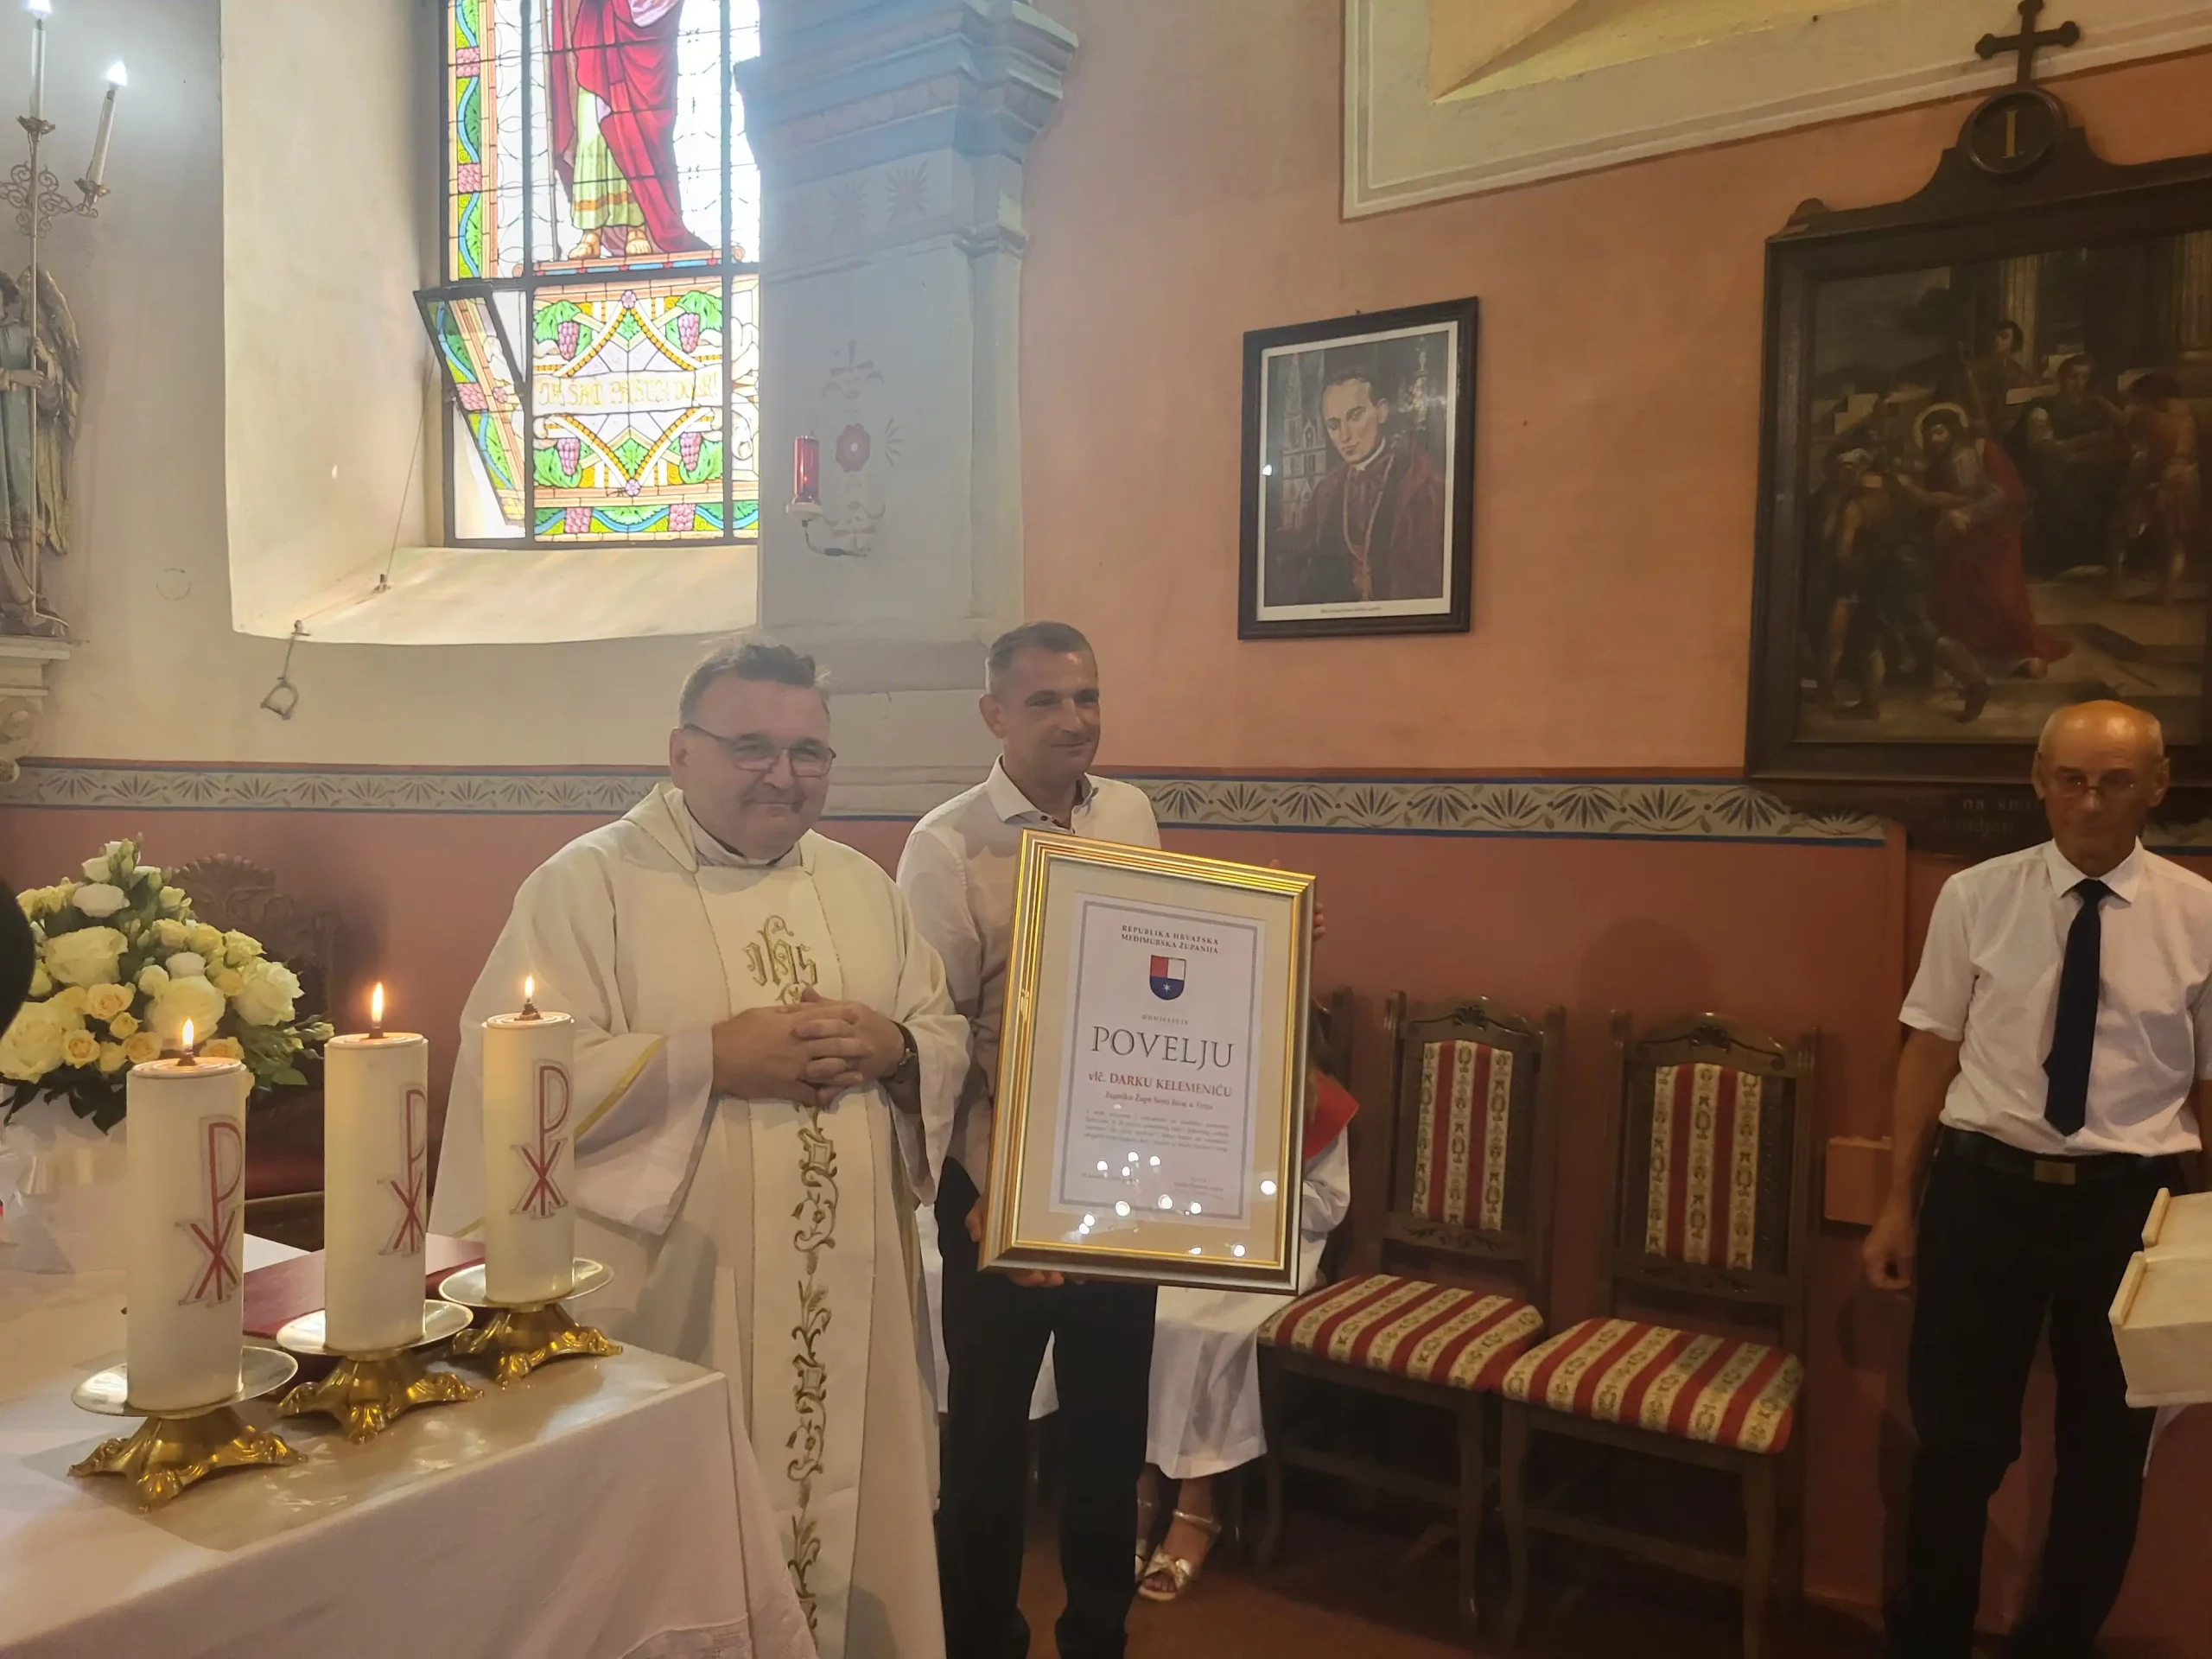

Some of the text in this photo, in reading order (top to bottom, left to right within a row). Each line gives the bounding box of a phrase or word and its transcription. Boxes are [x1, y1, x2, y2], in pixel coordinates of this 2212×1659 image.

[1122, 925, 1219, 945] REPUBLIKA HRVATSKA
[1179, 941, 1219, 954] ŽUPANIJA
[1090, 1026, 1236, 1071] POVELJU
[1109, 1073, 1153, 1089] DARKU
[1156, 1078, 1233, 1097] KELEMENIĆU
